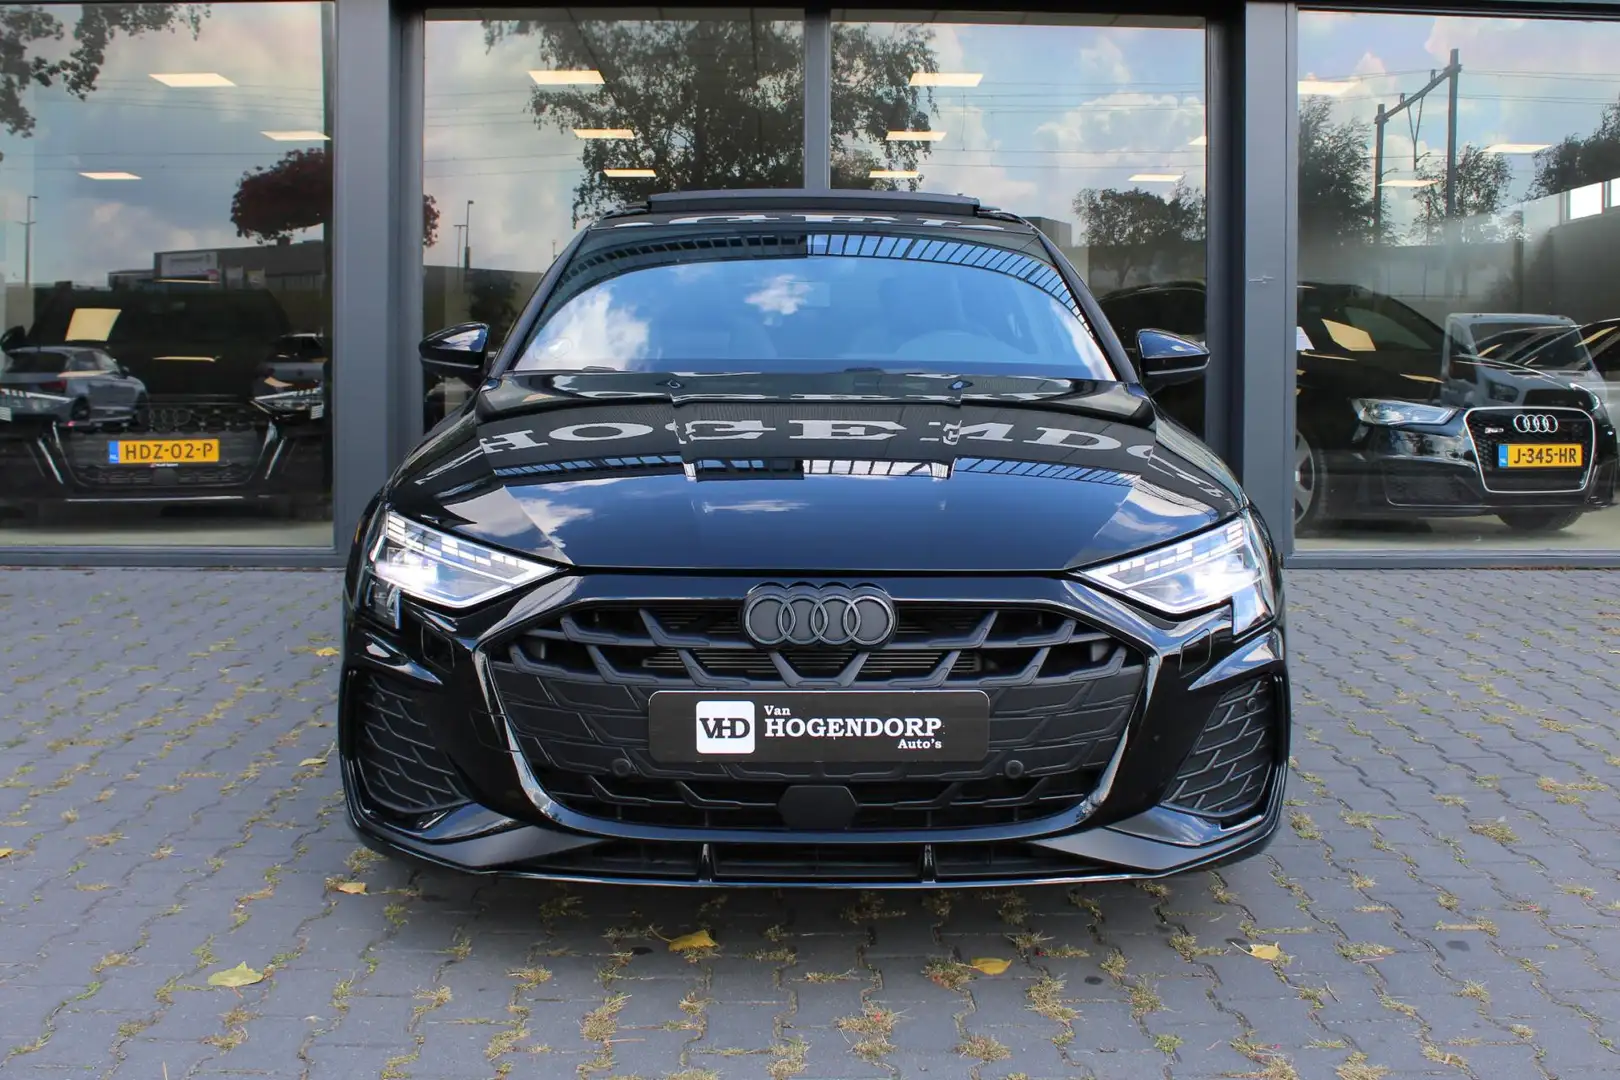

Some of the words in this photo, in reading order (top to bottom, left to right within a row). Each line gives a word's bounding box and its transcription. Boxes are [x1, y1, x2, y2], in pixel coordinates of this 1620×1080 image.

[125, 443, 213, 460] HDZ-02-P
[1513, 448, 1577, 464] J-345-HR
[764, 705, 791, 716] Van
[699, 717, 751, 739] VHD
[764, 718, 943, 737] HOGENDORP
[897, 739, 942, 749] Auto's
